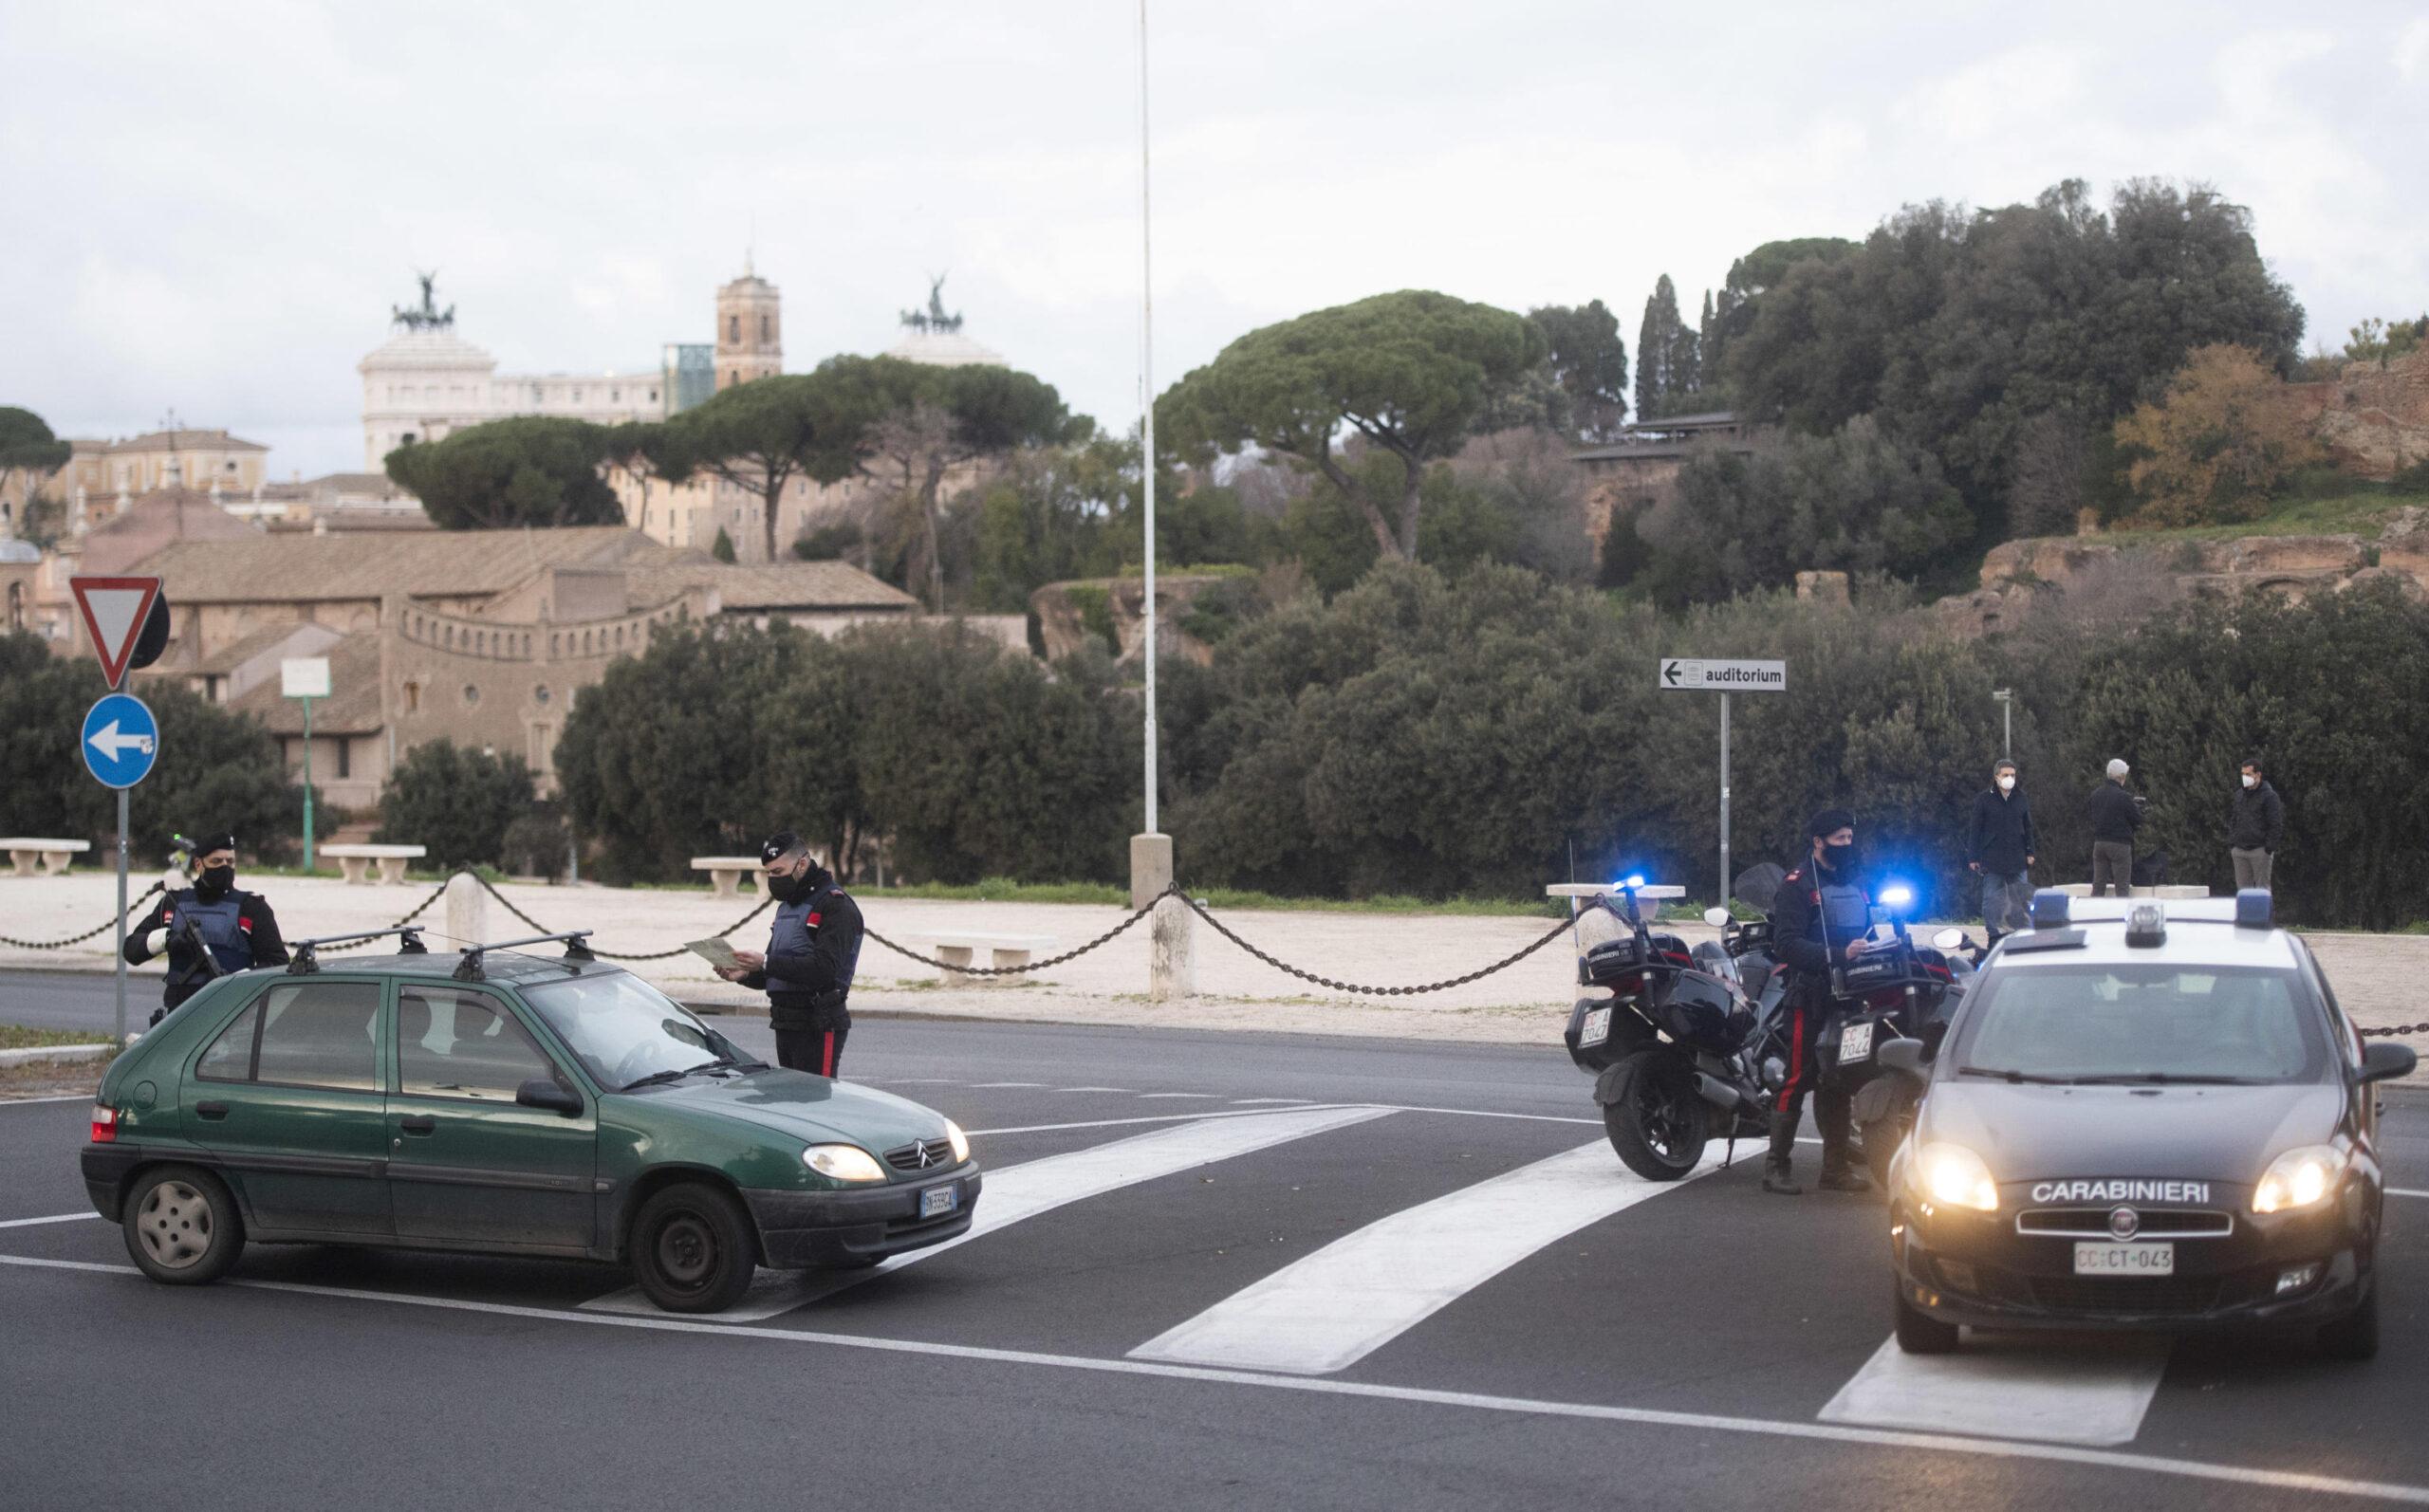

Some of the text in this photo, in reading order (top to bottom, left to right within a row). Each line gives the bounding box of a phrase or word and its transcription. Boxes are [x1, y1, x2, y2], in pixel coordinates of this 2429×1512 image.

[1706, 668, 1782, 682] auditorium
[1584, 1024, 1606, 1040] 7047
[1842, 1042, 1869, 1058] 7044
[2032, 1181, 2209, 1203] CARABINIERI
